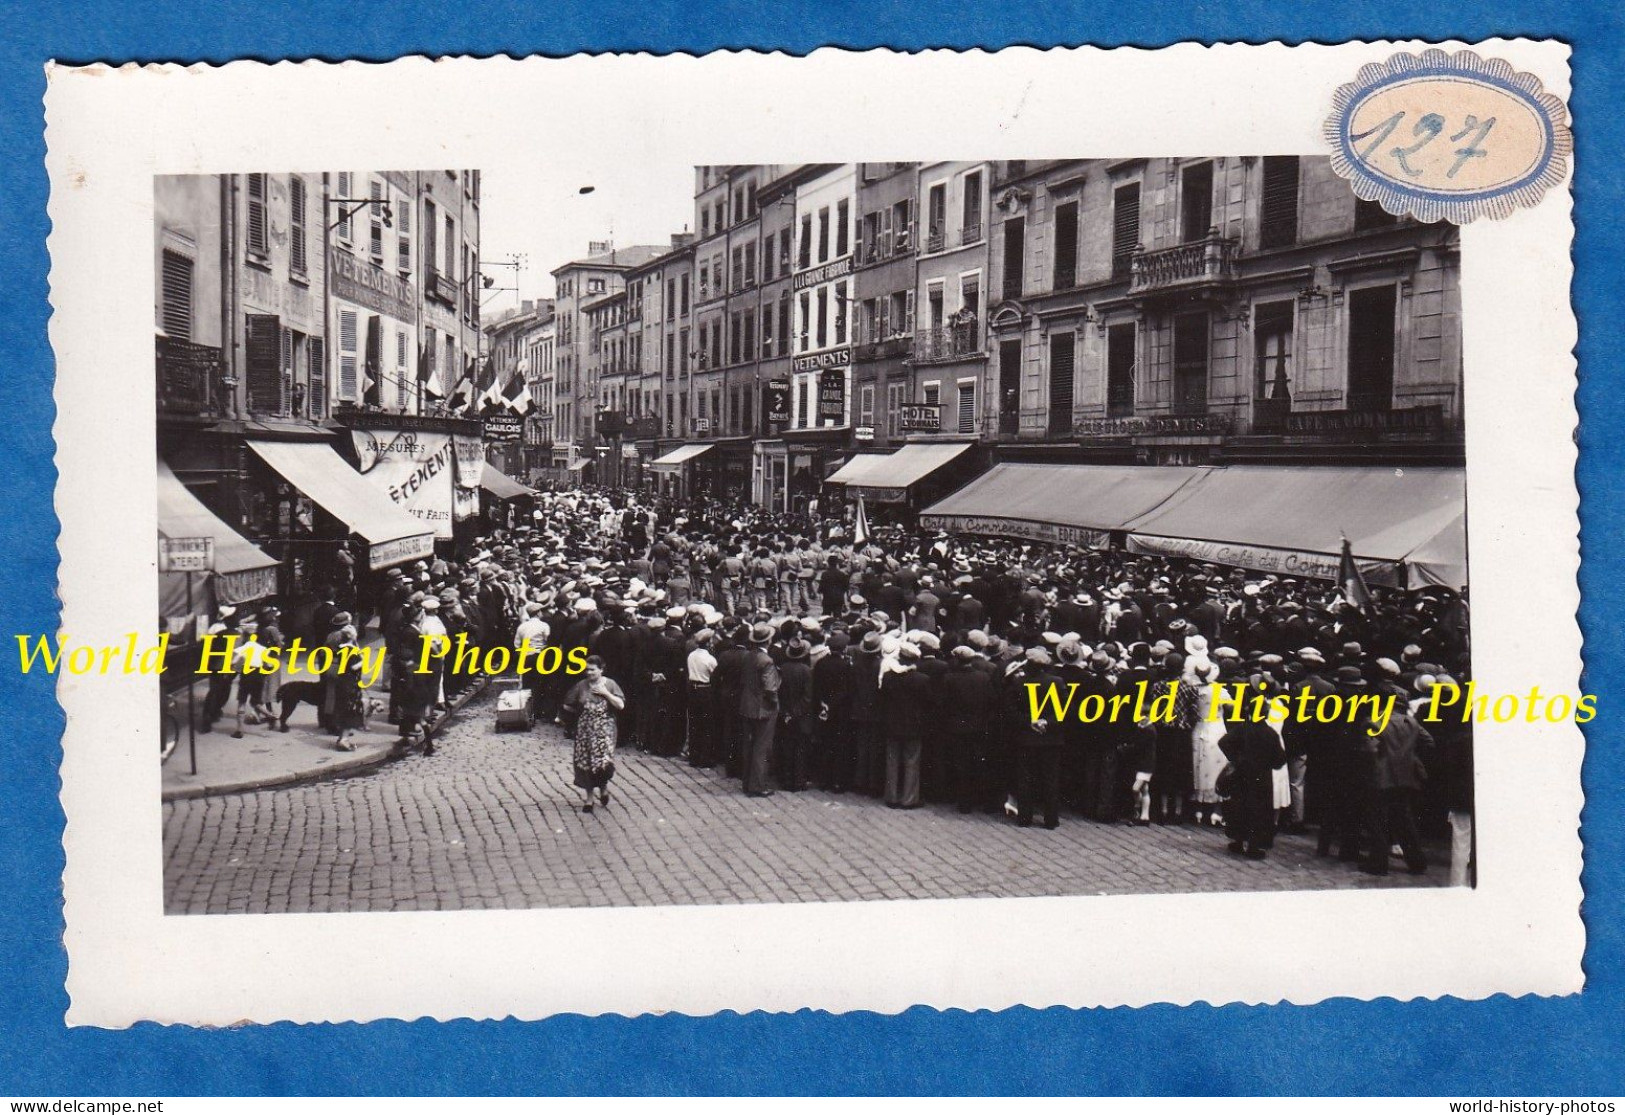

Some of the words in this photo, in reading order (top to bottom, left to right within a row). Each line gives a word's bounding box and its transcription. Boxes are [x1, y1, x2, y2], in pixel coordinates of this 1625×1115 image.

[1350, 111, 1496, 179] 127
[794, 350, 848, 370] VETEMENTS
[903, 406, 938, 419] HOTEL
[485, 423, 521, 433] GAULOIS
